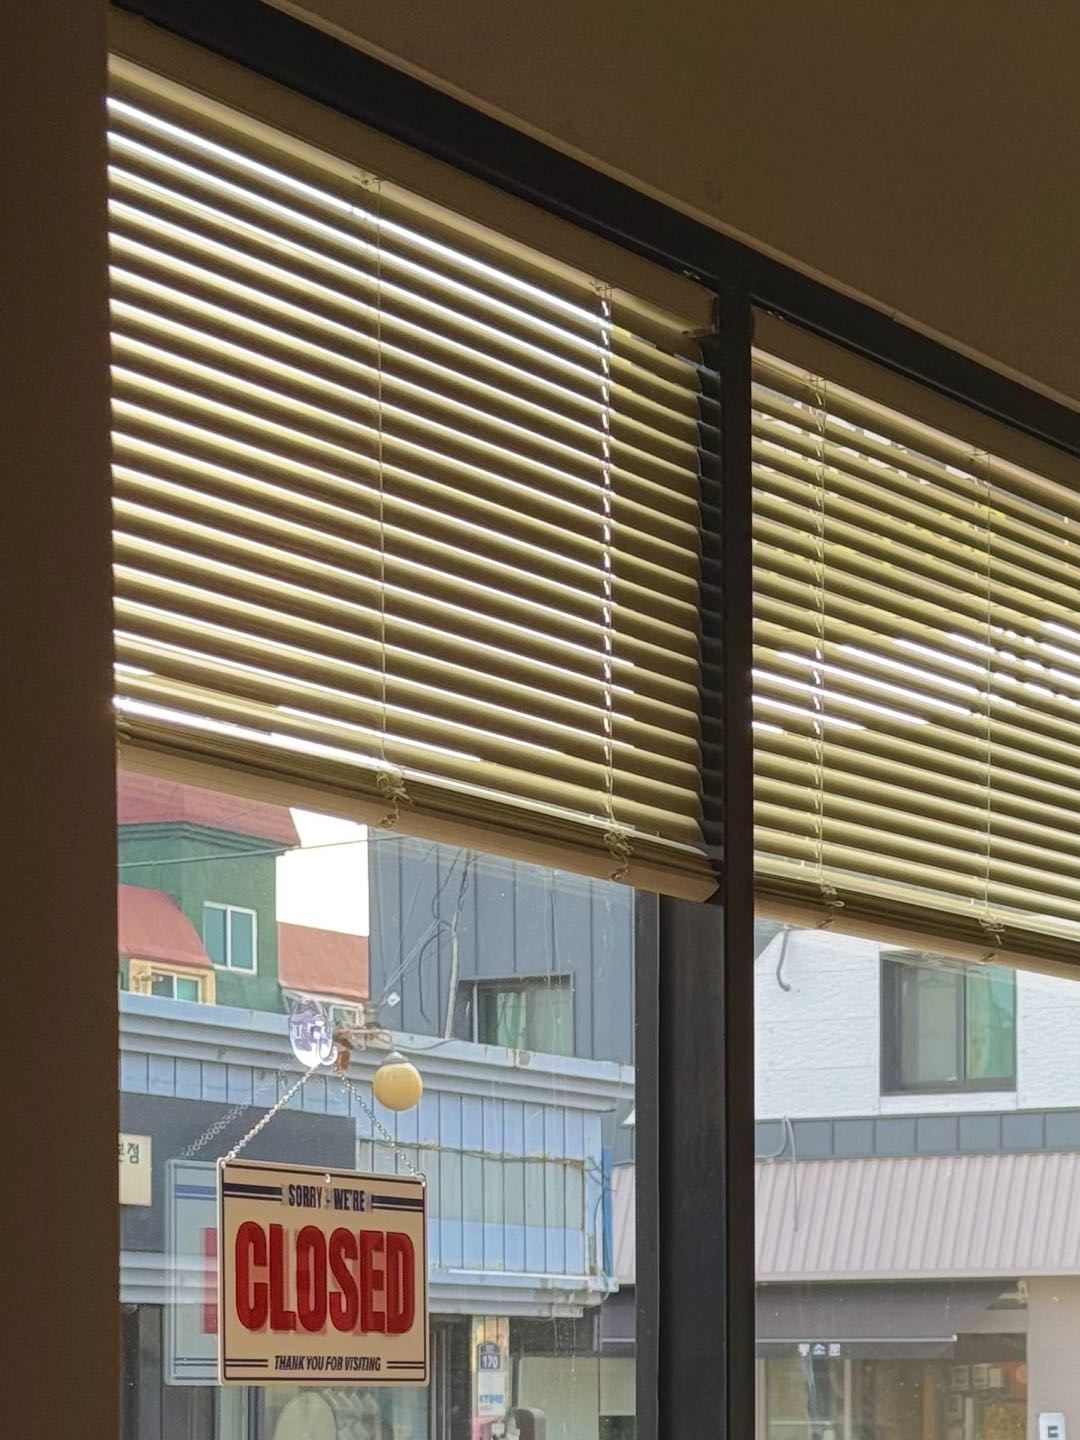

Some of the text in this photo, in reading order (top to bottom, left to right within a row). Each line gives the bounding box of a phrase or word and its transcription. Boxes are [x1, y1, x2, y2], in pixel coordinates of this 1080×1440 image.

[288, 1184, 365, 1212] SORRY WE'RE
[235, 1221, 416, 1334] CLOSED
[274, 1355, 381, 1372] THANK YOU FOR VISITING
